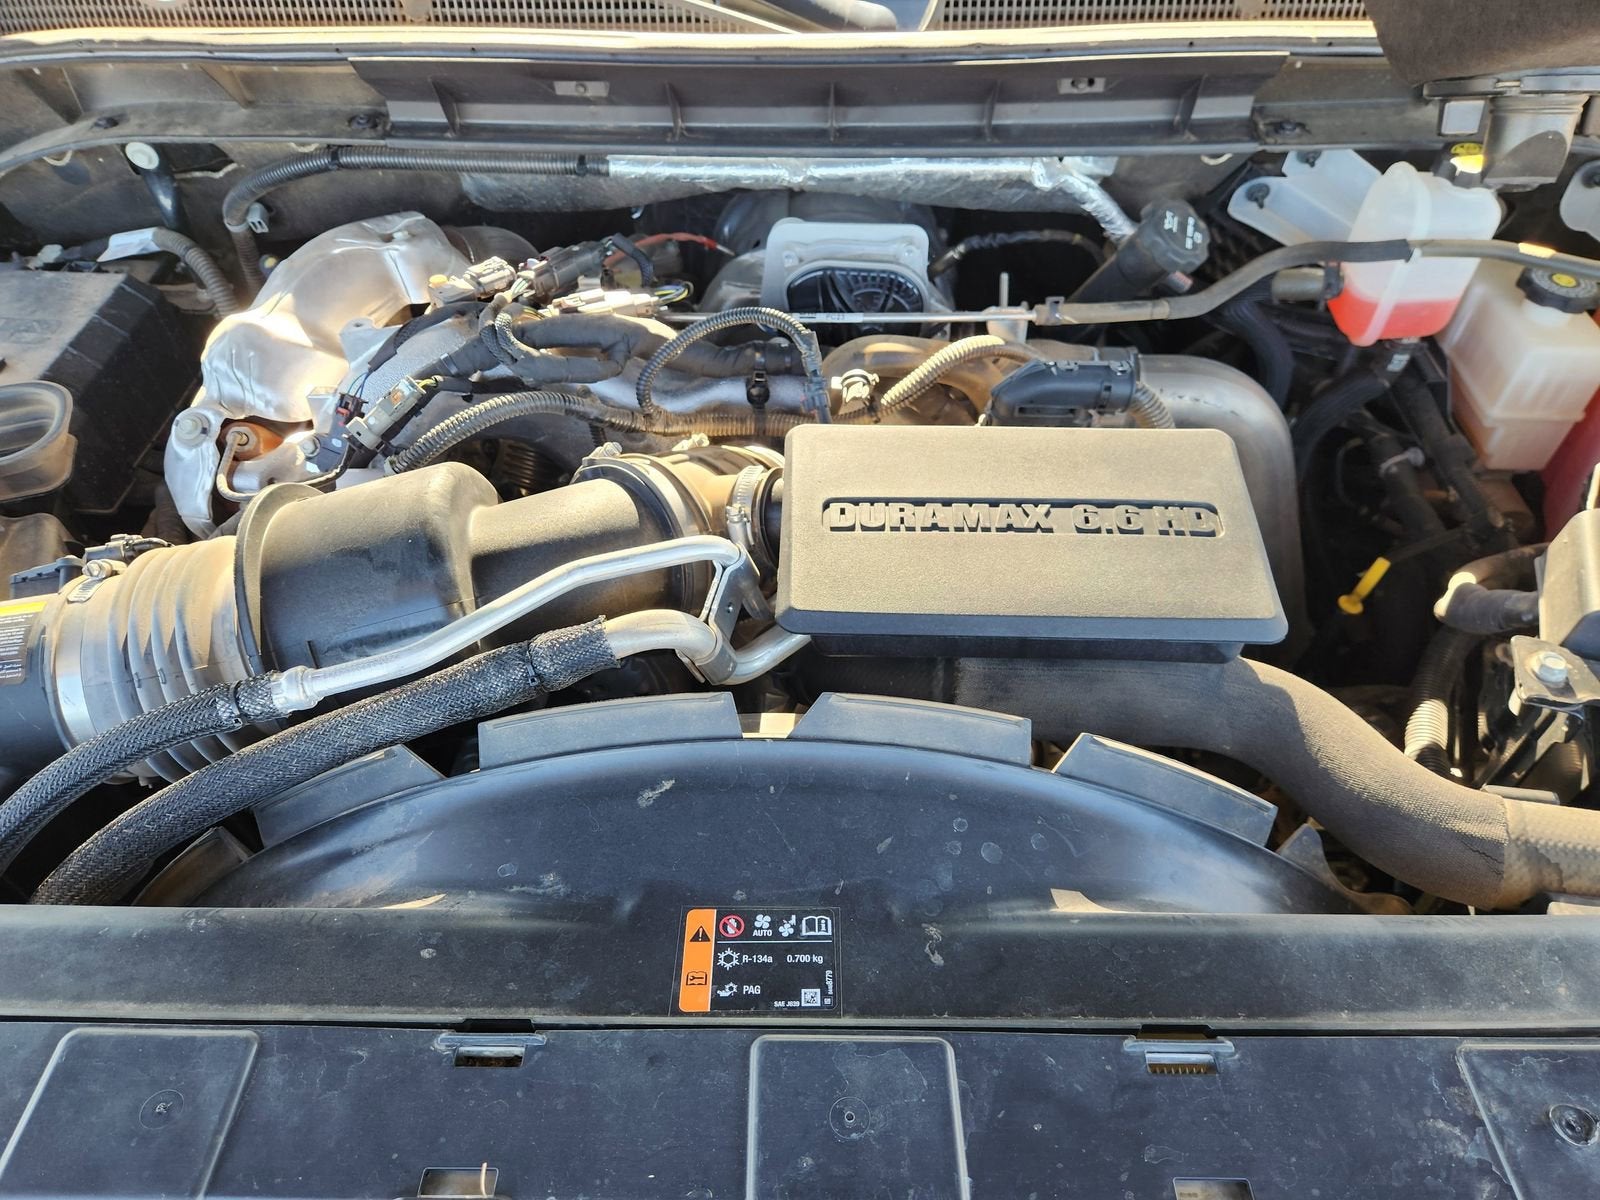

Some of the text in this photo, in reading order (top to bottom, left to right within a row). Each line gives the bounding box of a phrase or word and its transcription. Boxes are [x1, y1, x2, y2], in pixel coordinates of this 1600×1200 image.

[828, 502, 1218, 538] DURAMAX 6.6 HD
[742, 954, 824, 964] R-134a 0.700 kg
[742, 985, 761, 994] PAG
